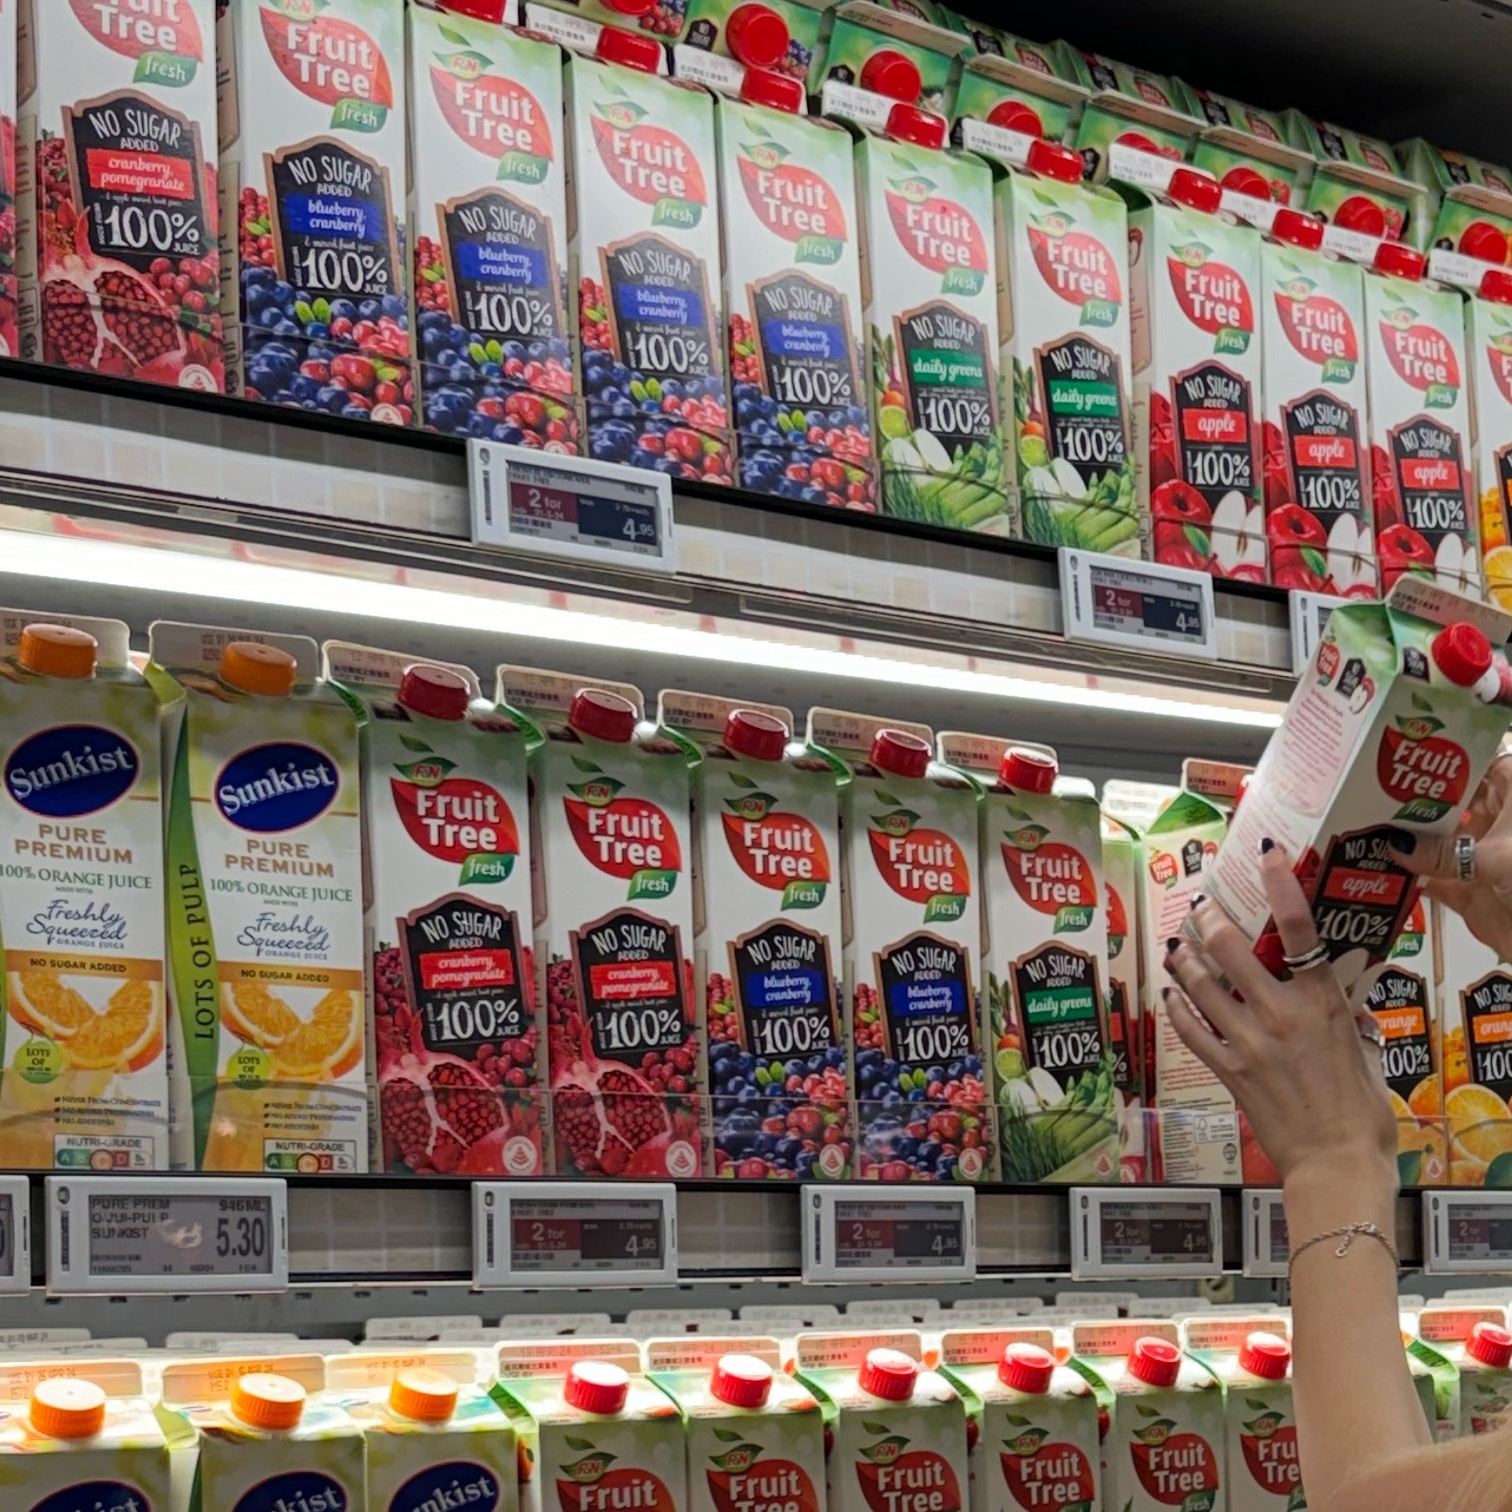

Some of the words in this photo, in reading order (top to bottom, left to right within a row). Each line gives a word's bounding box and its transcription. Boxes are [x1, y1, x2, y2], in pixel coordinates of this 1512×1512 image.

[92, 4, 177, 50] Tree
[287, 24, 374, 70] Fruit
[144, 57, 186, 81] fresh
[293, 54, 370, 98] Tree
[341, 103, 378, 126] fresh
[455, 82, 534, 125] Fruit
[89, 110, 120, 139] NO
[124, 108, 181, 148] SUGAR
[462, 110, 532, 151] Tree
[120, 137, 159, 151] ADDED
[101, 172, 185, 192] pomegranate
[288, 160, 317, 185] NO
[322, 156, 371, 194] SUGAR
[317, 184, 352, 196] ADDED
[104, 206, 199, 250] 100%
[310, 218, 365, 238] cranberry
[907, 204, 972, 242] Fruit
[173, 243, 200, 254] JUICE
[912, 228, 971, 266] Tree
[302, 250, 388, 292] 100%
[948, 272, 978, 291] fresh
[1185, 270, 1242, 304] Fruit
[1189, 292, 1240, 327] Tree
[911, 317, 934, 341] NO
[937, 314, 974, 344] SUGAR
[914, 358, 947, 381] daily
[948, 362, 983, 381] greens
[927, 400, 990, 434] 100%
[1197, 416, 1236, 438] apple
[1194, 451, 1250, 486] 100%
[529, 488, 542, 508] 2
[545, 498, 561, 510] for
[9, 745, 134, 800] Sunkist
[1392, 738, 1463, 780] Fruit
[219, 763, 335, 816] Sunkist
[1389, 764, 1448, 799] Tree
[417, 789, 500, 823] Fruit
[1406, 800, 1439, 820] fresh
[39, 824, 106, 845] PURE
[246, 839, 309, 858] PURE
[421, 817, 497, 850] Tree
[14, 840, 132, 864] PREMIUM
[224, 854, 334, 877] PREMIUM
[1345, 839, 1369, 861] NO
[0, 865, 36, 880] 100%
[39, 869, 105, 887] ORANGE
[108, 873, 152, 890] JUICE
[468, 859, 506, 878] fresh
[181, 864, 205, 925] PULP
[1342, 875, 1389, 896] apple
[26, 913, 128, 945] Squeezed
[46, 899, 124, 928] Freshly
[420, 915, 448, 942] NO
[453, 911, 501, 941] SUGAR
[1318, 914, 1392, 944] 100%
[190, 938, 211, 969] OF
[449, 938, 483, 949] ADDED
[30, 959, 47, 967] NO
[50, 960, 87, 970] SUGAR
[90, 963, 126, 972] ADDED
[432, 968, 506, 987] pomegranate
[195, 979, 214, 1040] LOTS
[437, 998, 519, 1041] 100%
[1028, 997, 1059, 1016] daily
[1061, 996, 1092, 1015] greens
[217, 1218, 264, 1256] 5.30
[877, 1461, 944, 1490] Fruit
[580, 1480, 657, 1511] Fruit
